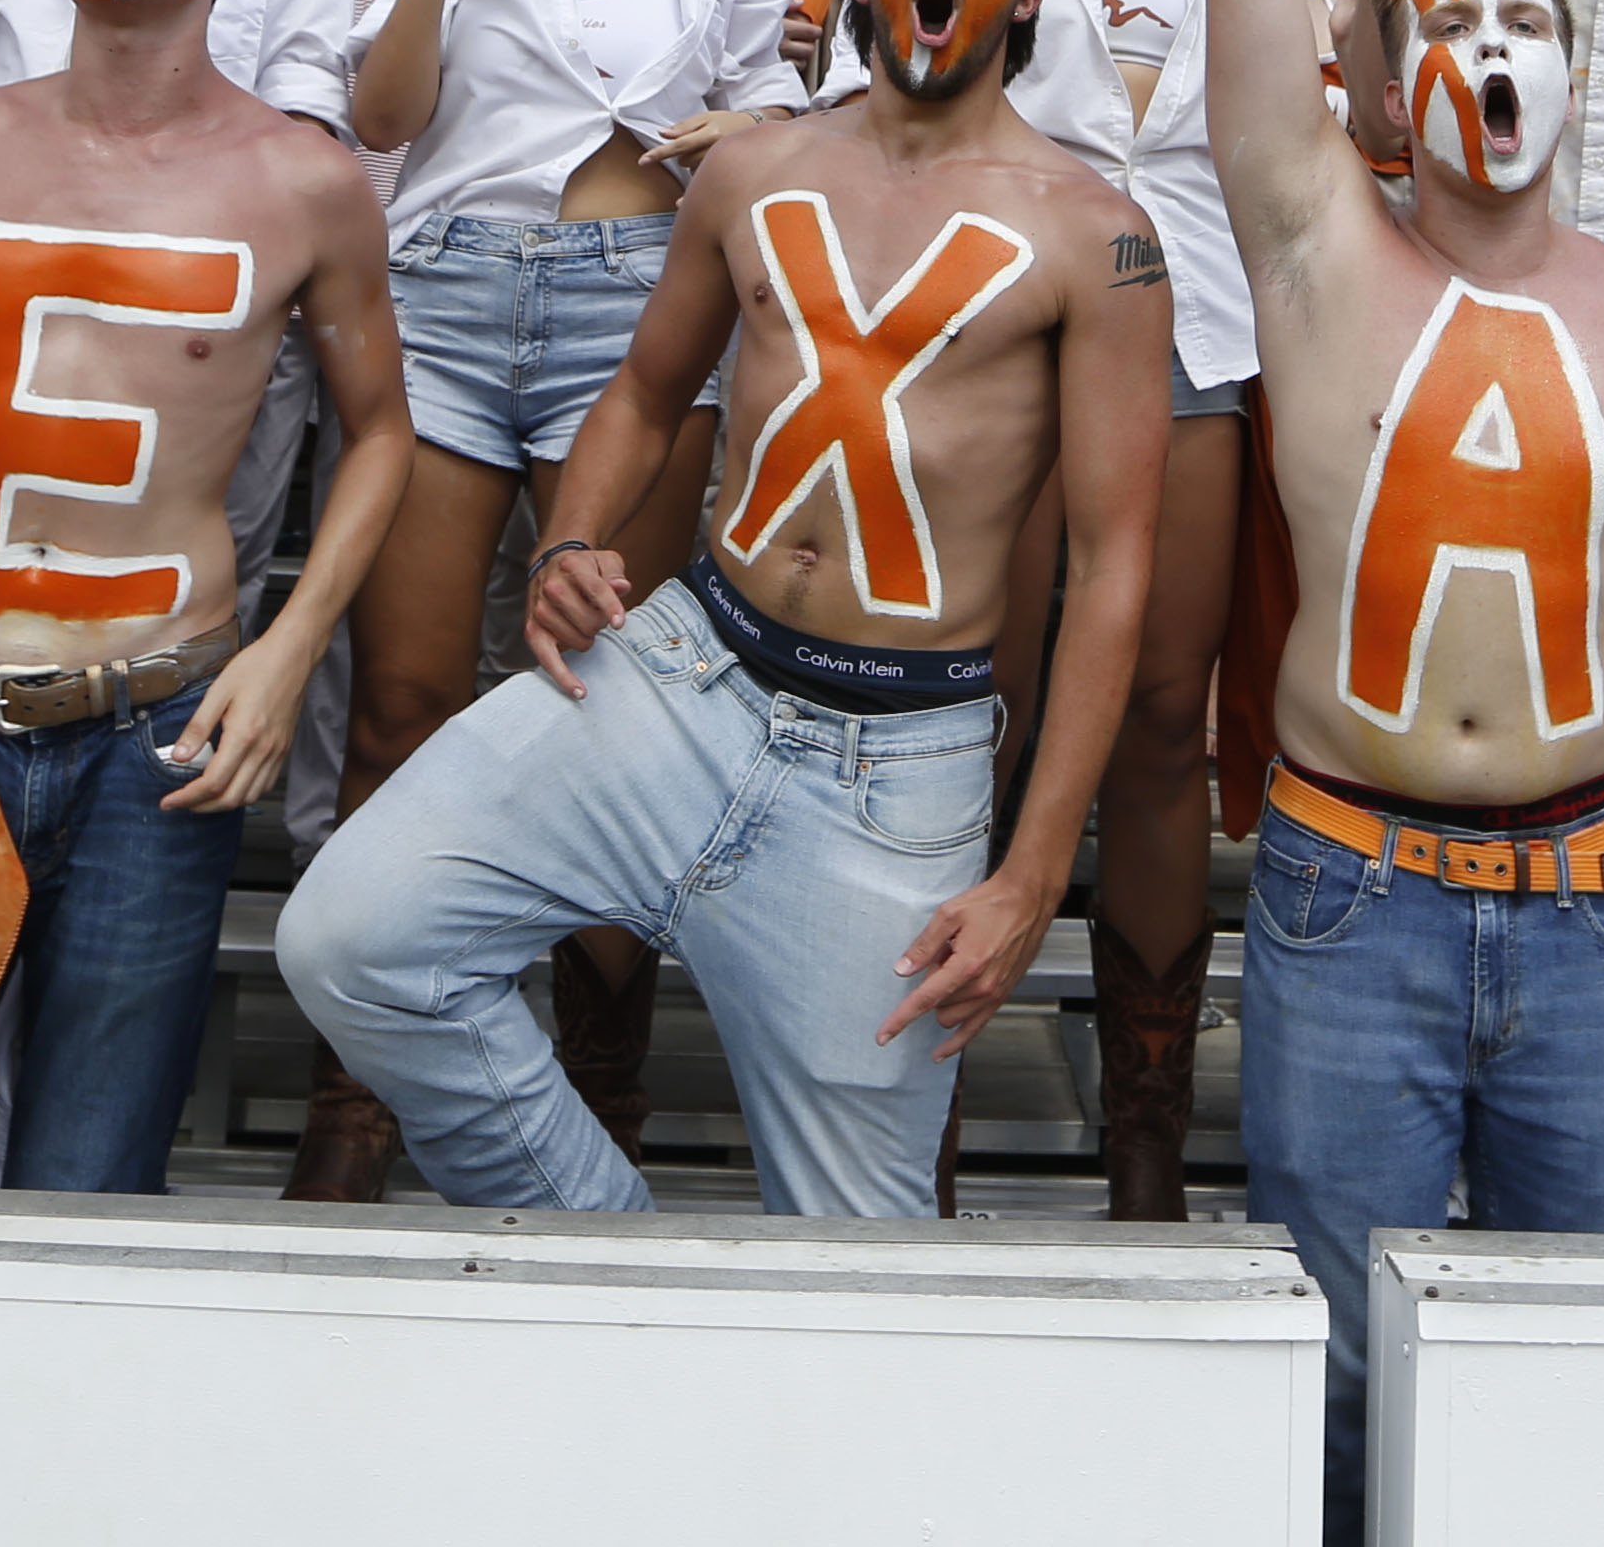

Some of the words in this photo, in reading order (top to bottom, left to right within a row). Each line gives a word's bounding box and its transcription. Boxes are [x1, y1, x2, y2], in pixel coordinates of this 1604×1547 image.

[721, 190, 1034, 620] X
[707, 575, 732, 616] Calvin
[730, 610, 761, 641] Klein
[796, 646, 854, 674] Calvin
[859, 659, 904, 678] Klein
